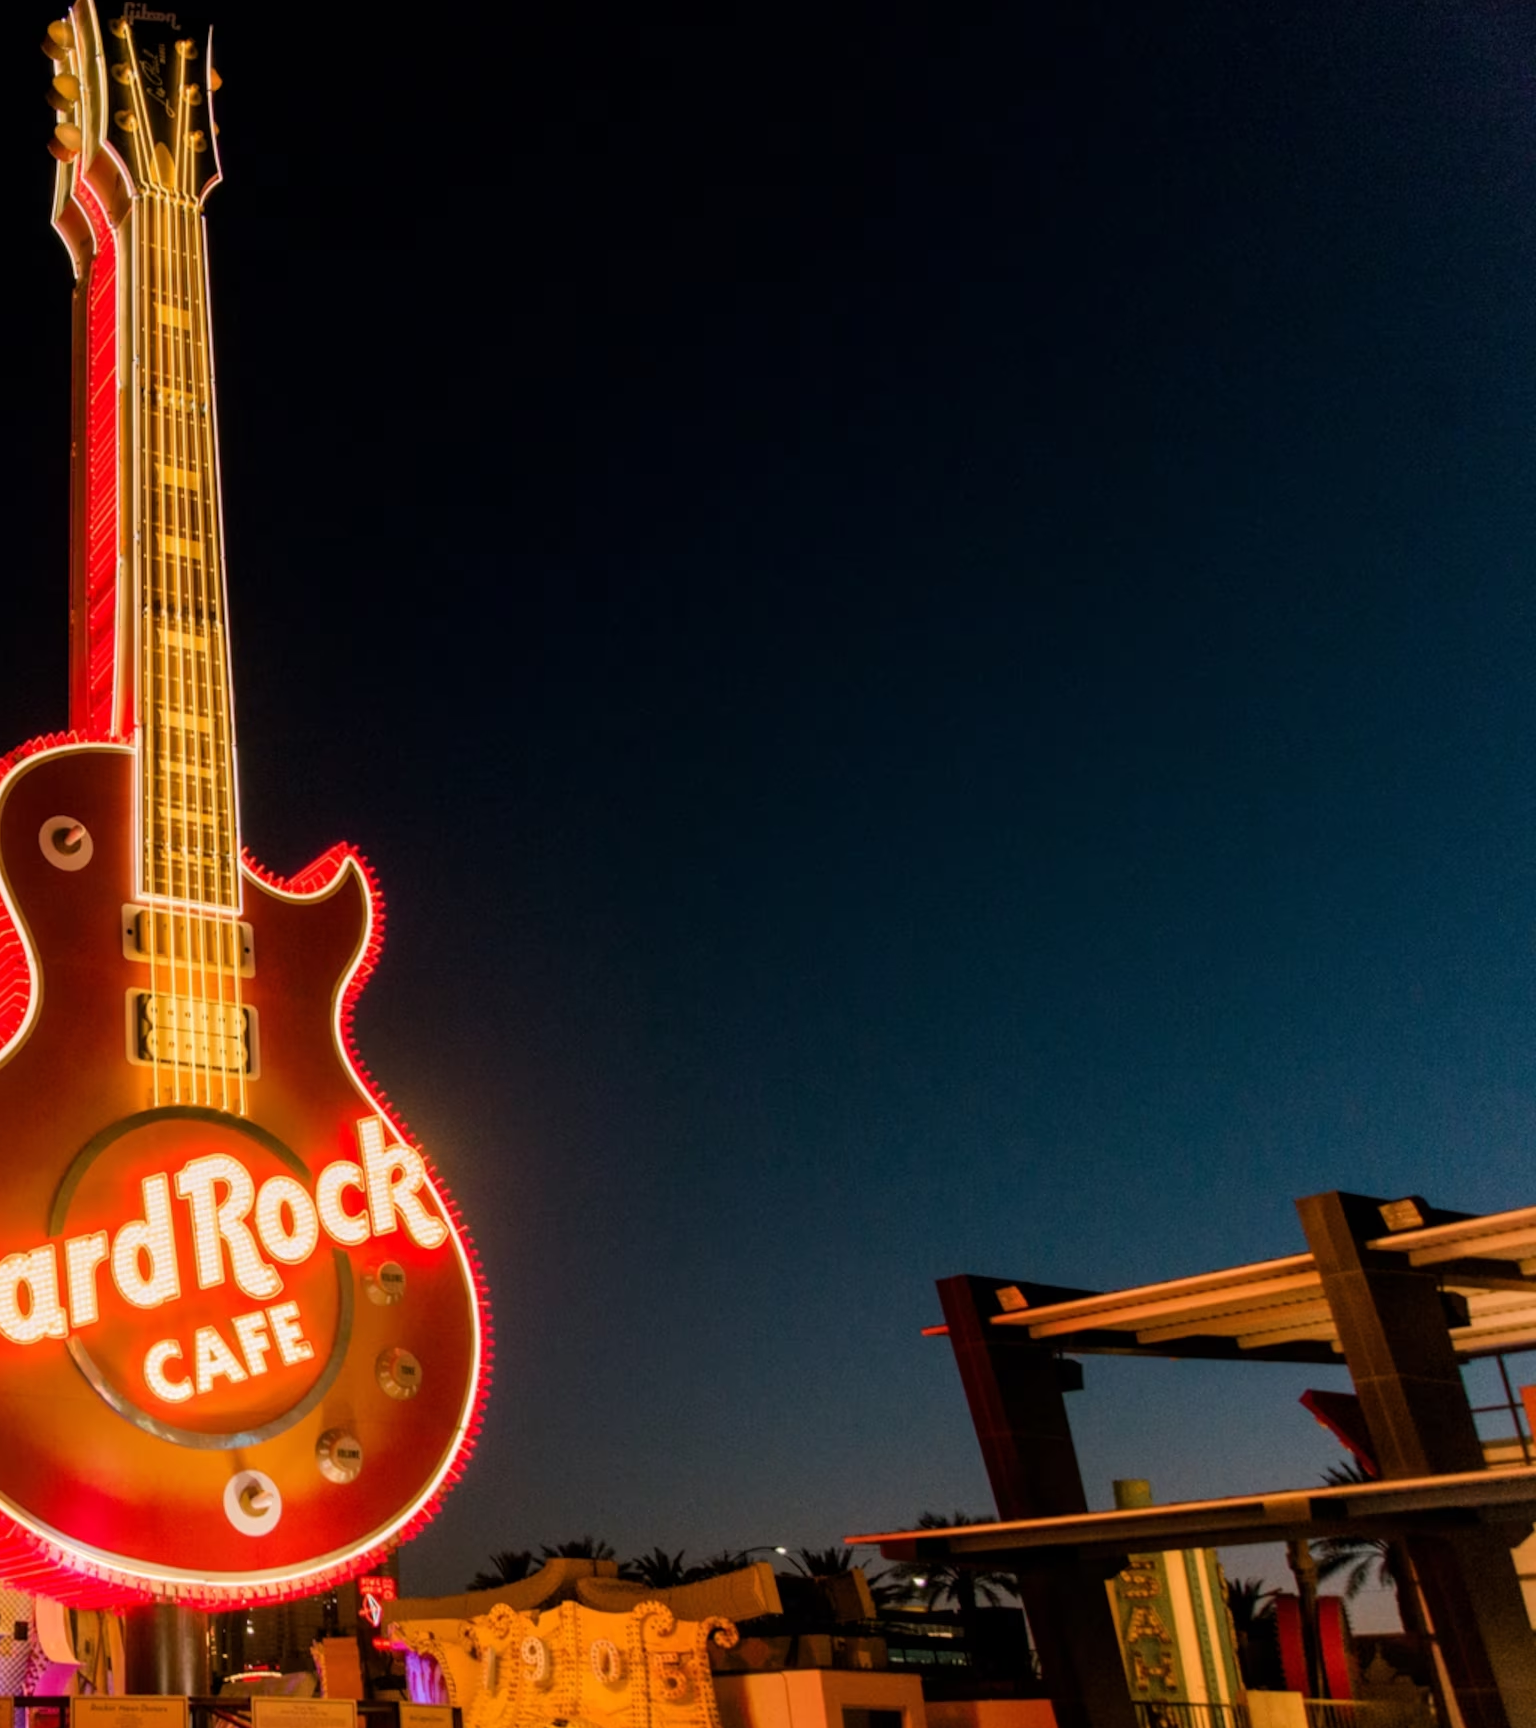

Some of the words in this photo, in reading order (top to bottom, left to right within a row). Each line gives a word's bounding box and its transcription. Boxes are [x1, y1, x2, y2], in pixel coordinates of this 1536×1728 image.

[123, 2, 182, 31] Gibson
[174, 1115, 448, 1300] Rock
[142, 1300, 315, 1404] CAFE
